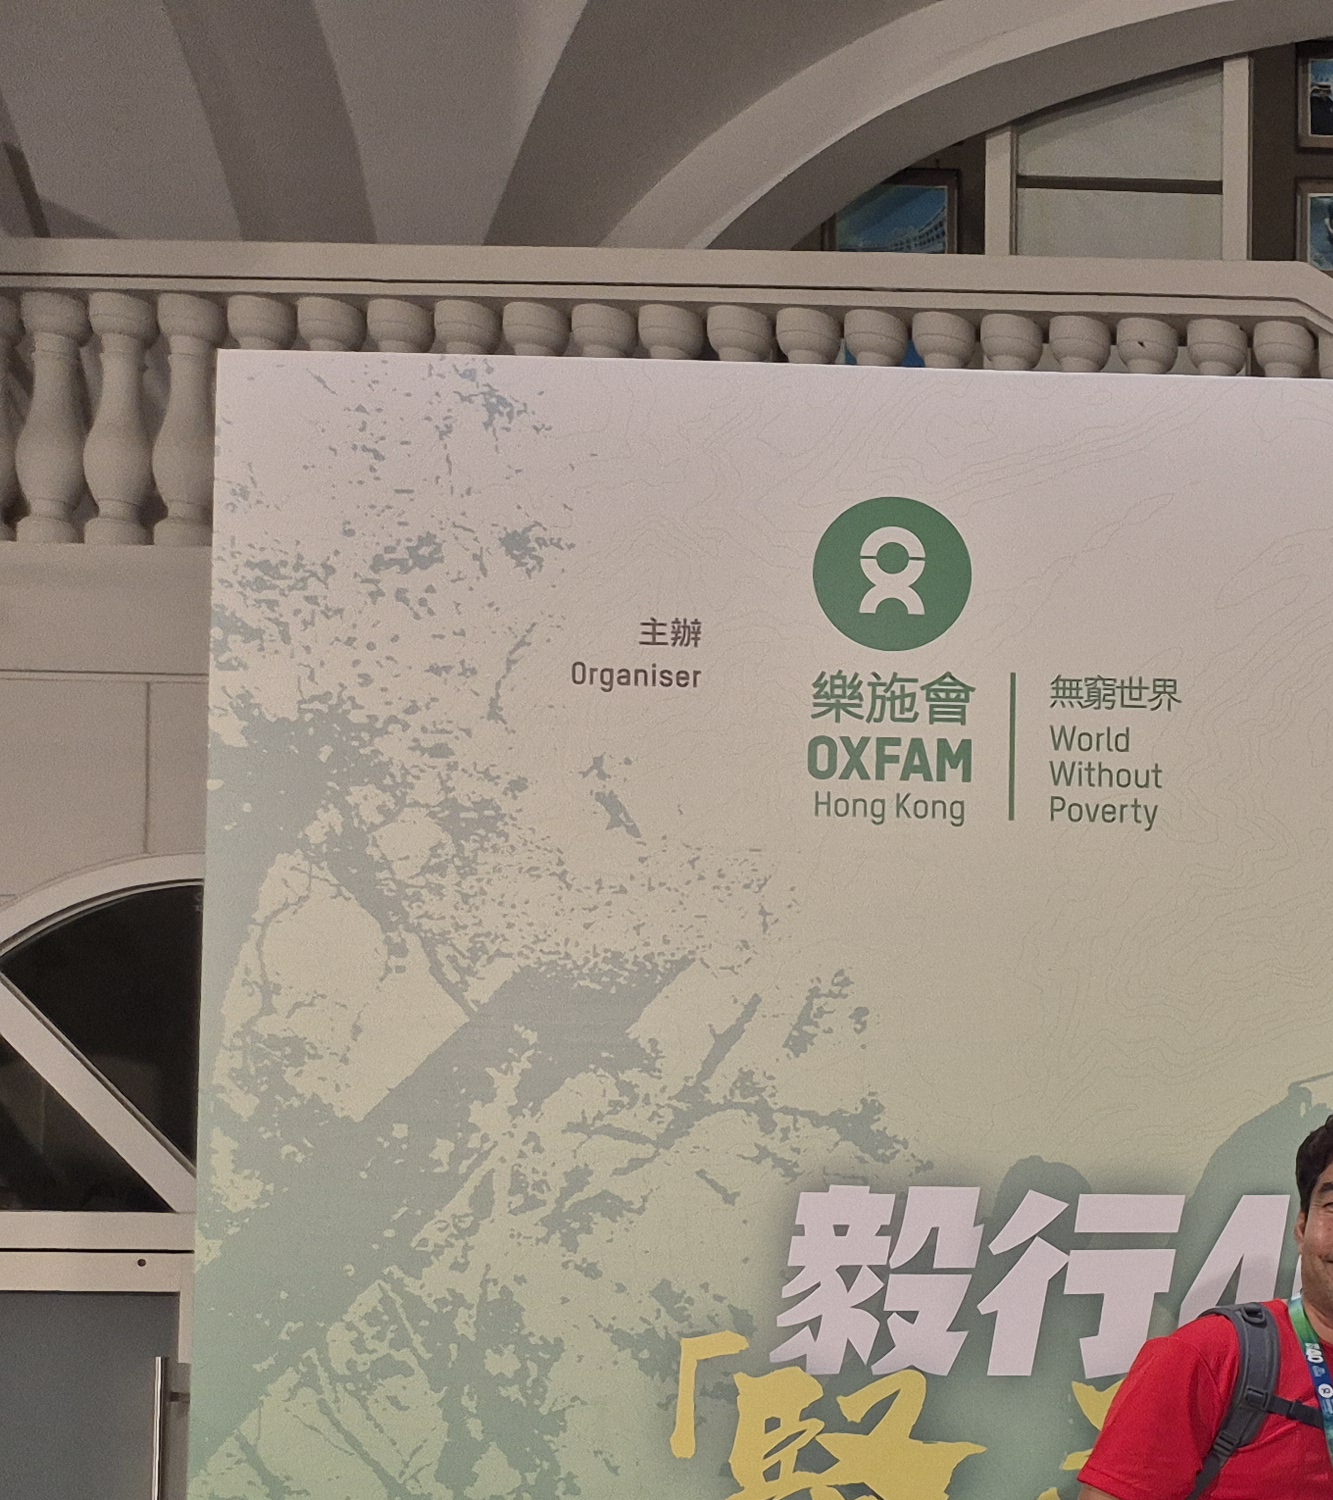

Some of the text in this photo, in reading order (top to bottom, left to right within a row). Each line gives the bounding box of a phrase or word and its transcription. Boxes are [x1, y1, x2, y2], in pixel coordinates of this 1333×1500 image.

[639, 616, 702, 649] 主辦
[570, 660, 702, 691] Organiser
[1049, 674, 1182, 712] 無窮世界
[810, 670, 976, 725] 樂施會
[1049, 725, 1132, 754] World
[807, 736, 973, 783] OXFAM
[1049, 760, 1164, 790] Without
[813, 791, 966, 827] Hong Kong
[1049, 797, 1159, 831] Poverty
[770, 1184, 1302, 1379] 毅行4
